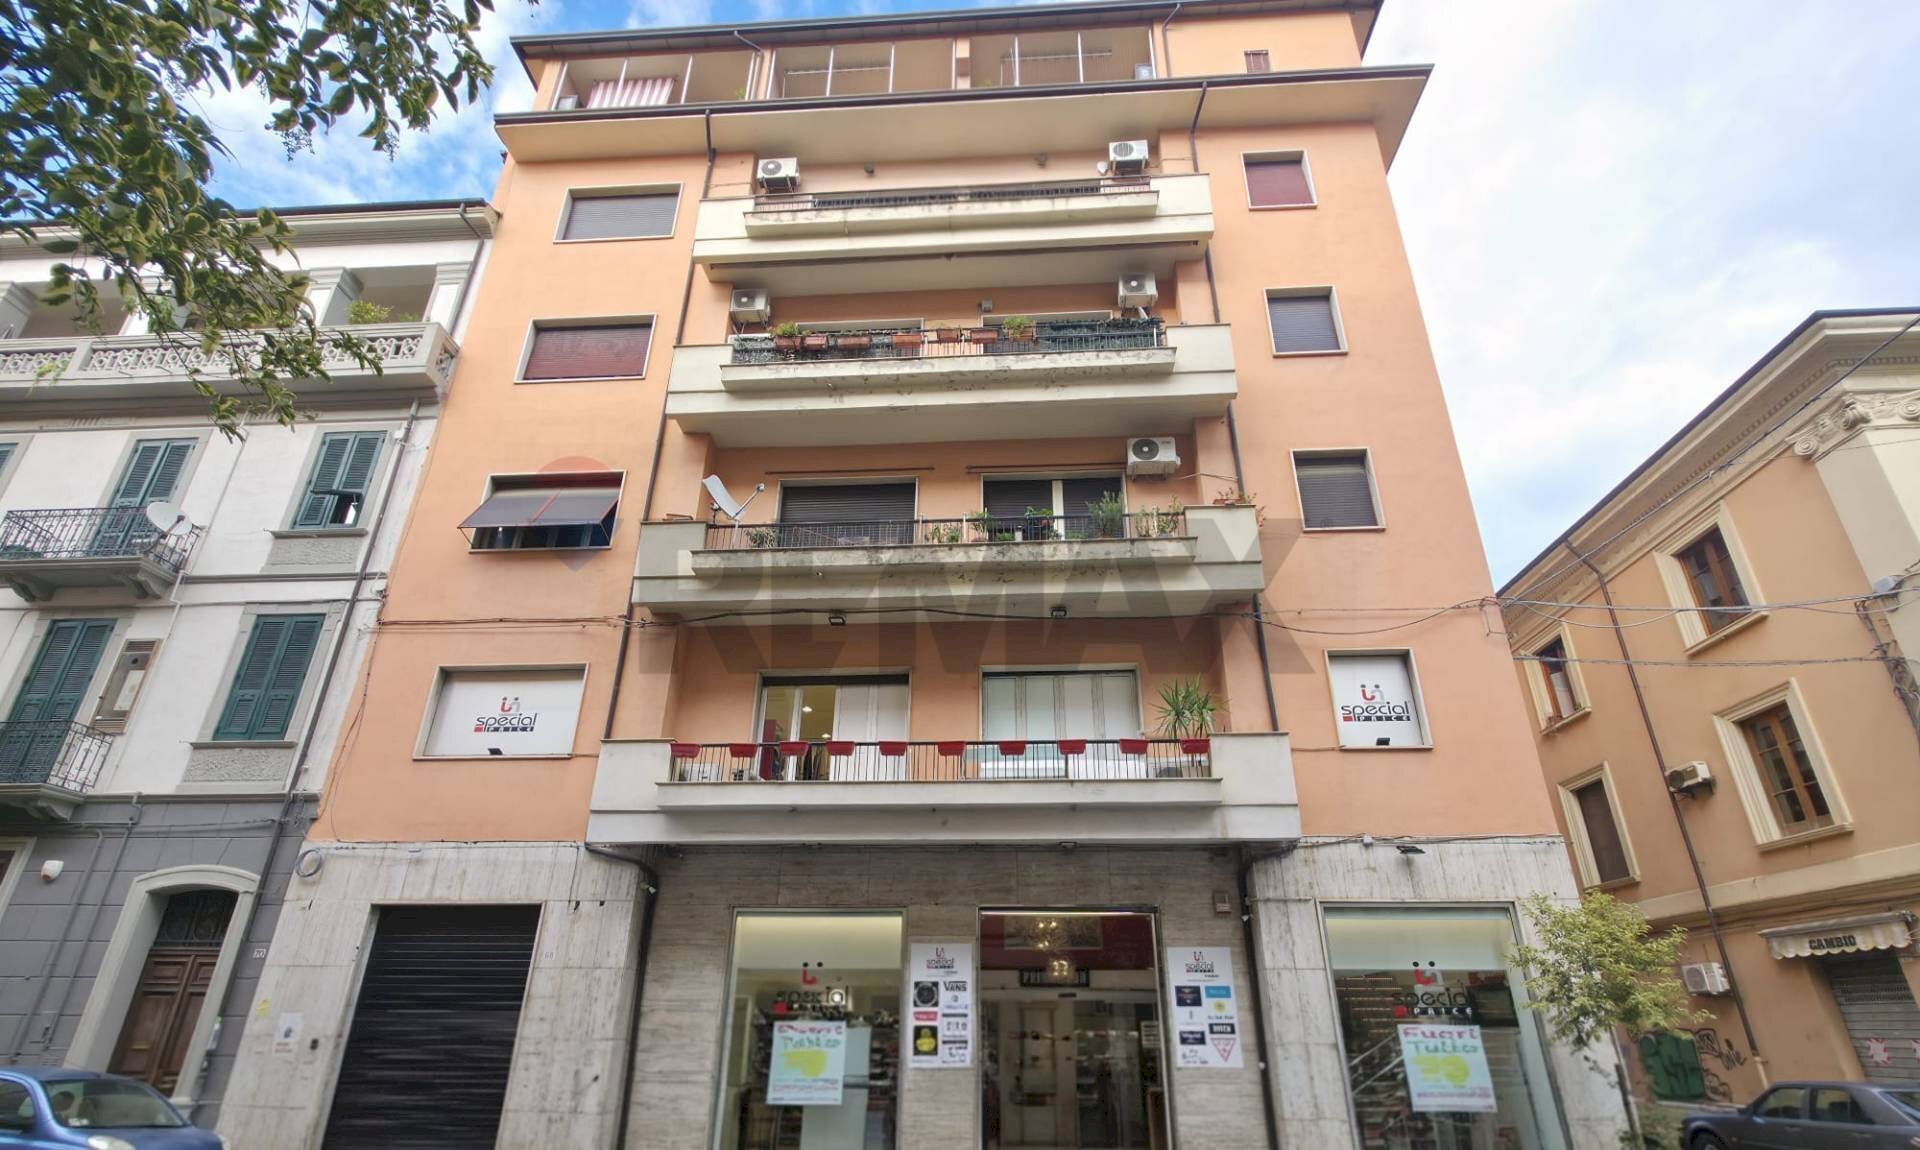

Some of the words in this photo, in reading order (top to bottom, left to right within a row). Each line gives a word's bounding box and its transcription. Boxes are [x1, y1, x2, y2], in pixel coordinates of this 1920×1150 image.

[1341, 701, 1410, 721] special
[476, 713, 538, 732] special
[1808, 935, 1857, 950] CAMBIO
[943, 980, 968, 992] VANS
[1414, 1007, 1473, 1015] PRICE
